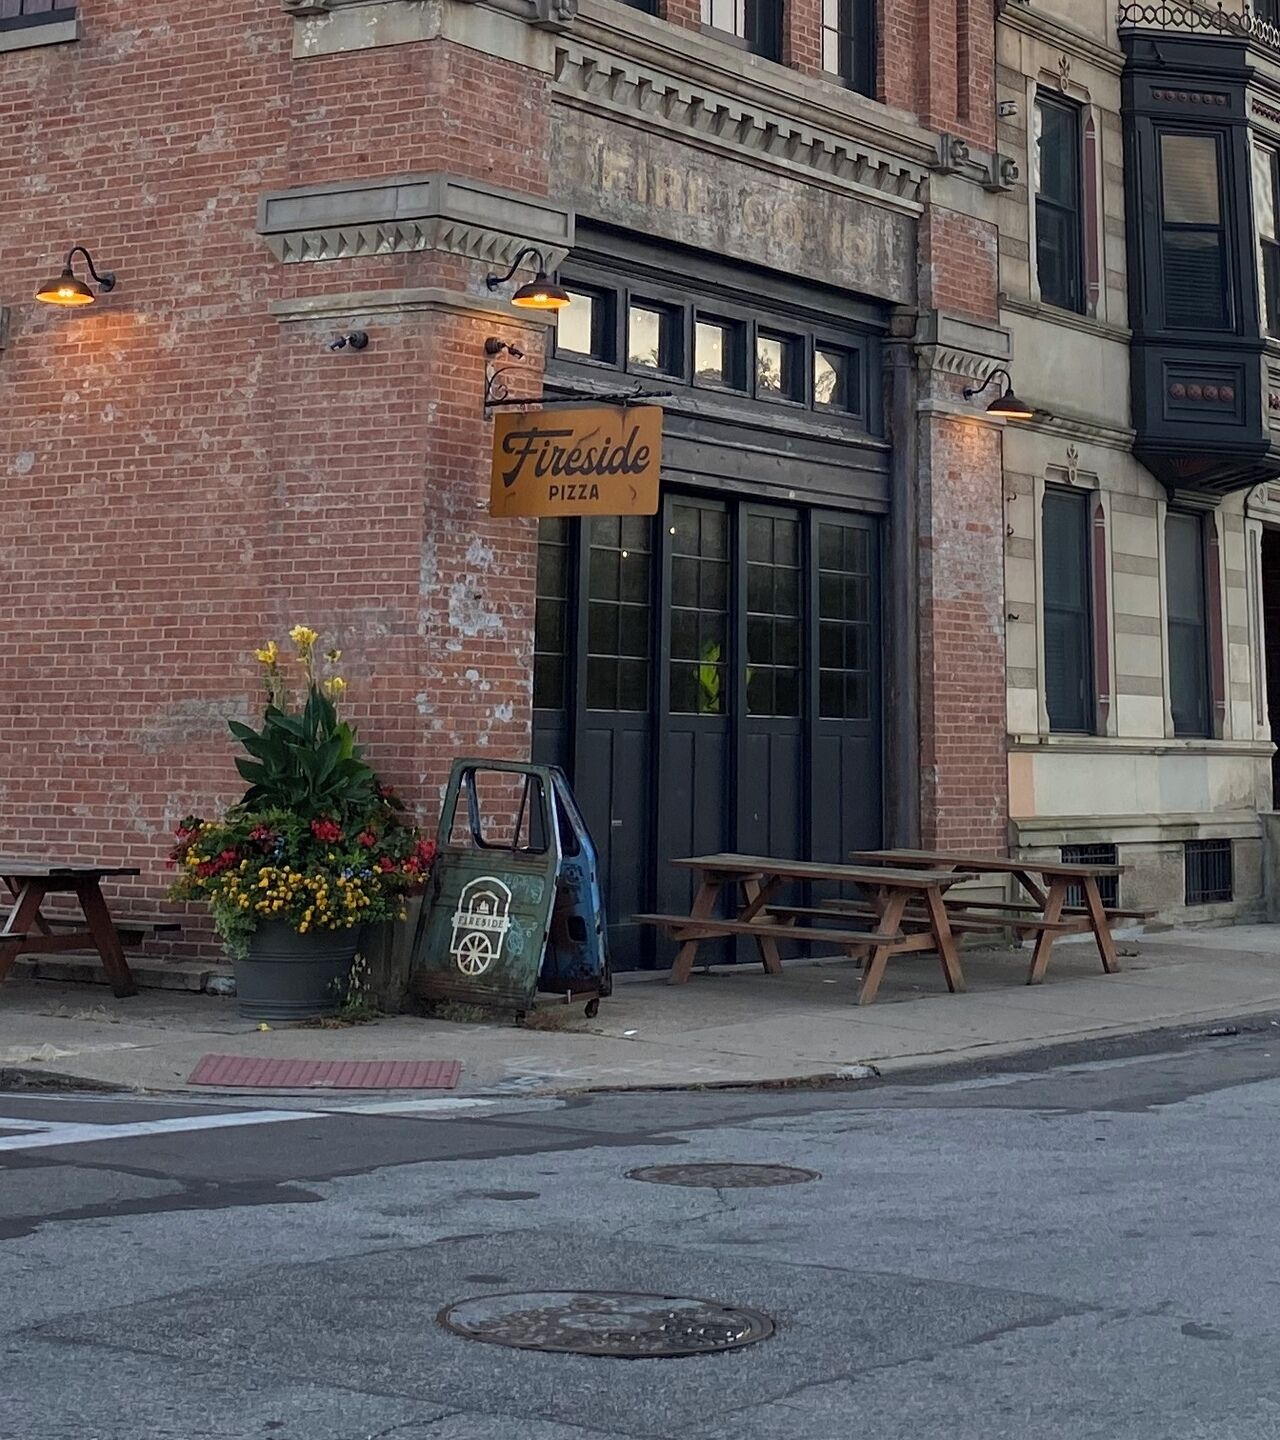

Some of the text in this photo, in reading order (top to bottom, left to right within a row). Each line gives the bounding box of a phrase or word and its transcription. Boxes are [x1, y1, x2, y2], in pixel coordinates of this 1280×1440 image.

[502, 426, 651, 488] Fireside
[548, 483, 600, 501] PIZZA
[457, 915, 505, 929] FIRESIDE
